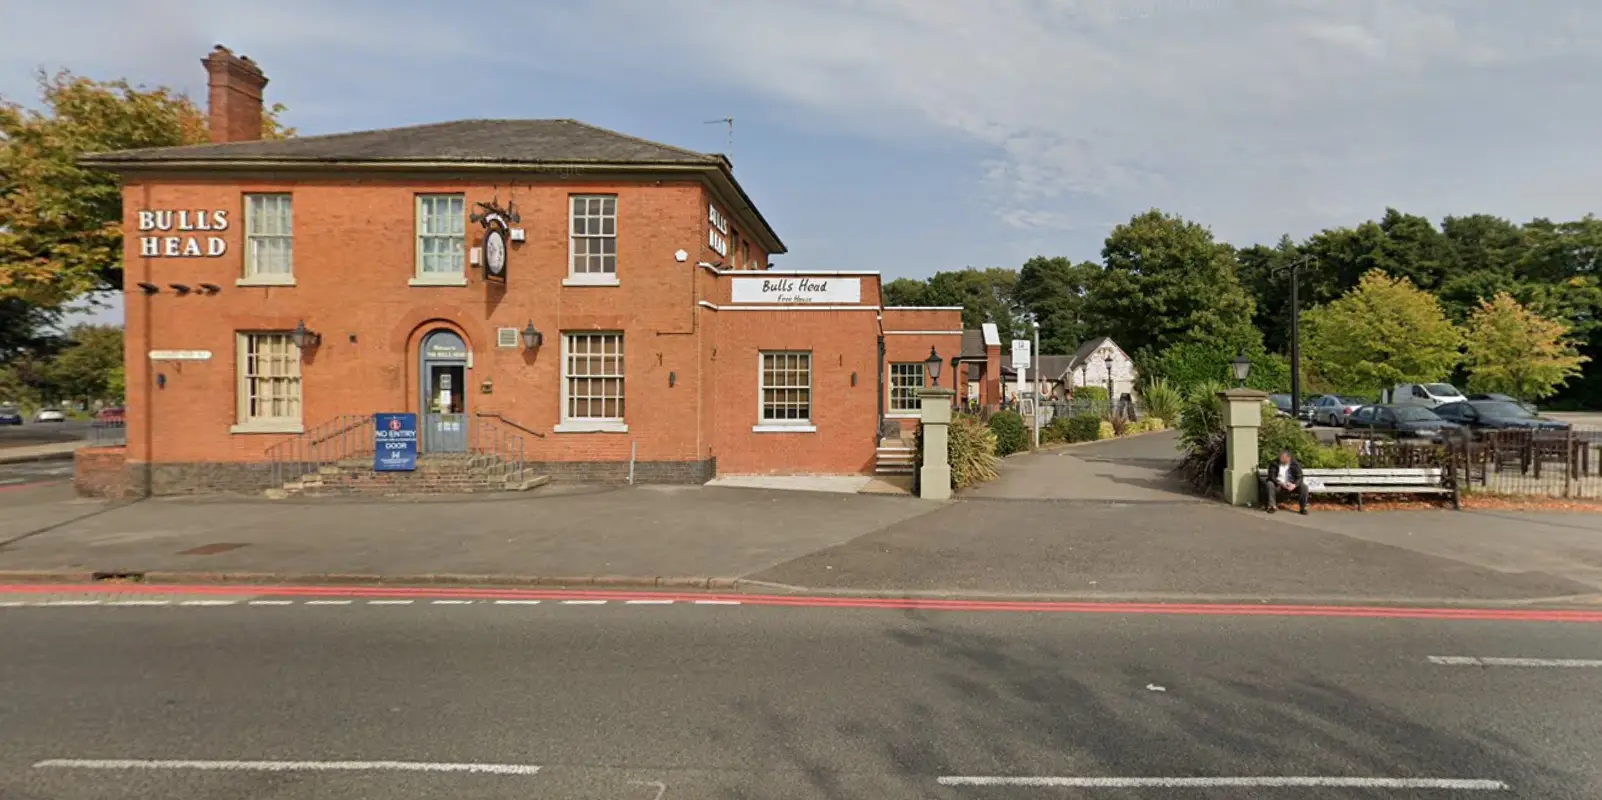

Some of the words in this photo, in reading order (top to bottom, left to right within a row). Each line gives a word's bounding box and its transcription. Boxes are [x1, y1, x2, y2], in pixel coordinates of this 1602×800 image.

[138, 209, 230, 231] BULLS
[709, 203, 727, 235] BULLS
[138, 236, 228, 257] HEAD
[709, 228, 727, 257] HEAD
[762, 279, 794, 292] Bulls
[798, 278, 828, 292] Head
[777, 294, 792, 303] Free
[376, 430, 388, 438] NO
[389, 430, 416, 438] ENTRY
[385, 442, 408, 450] DOOR
